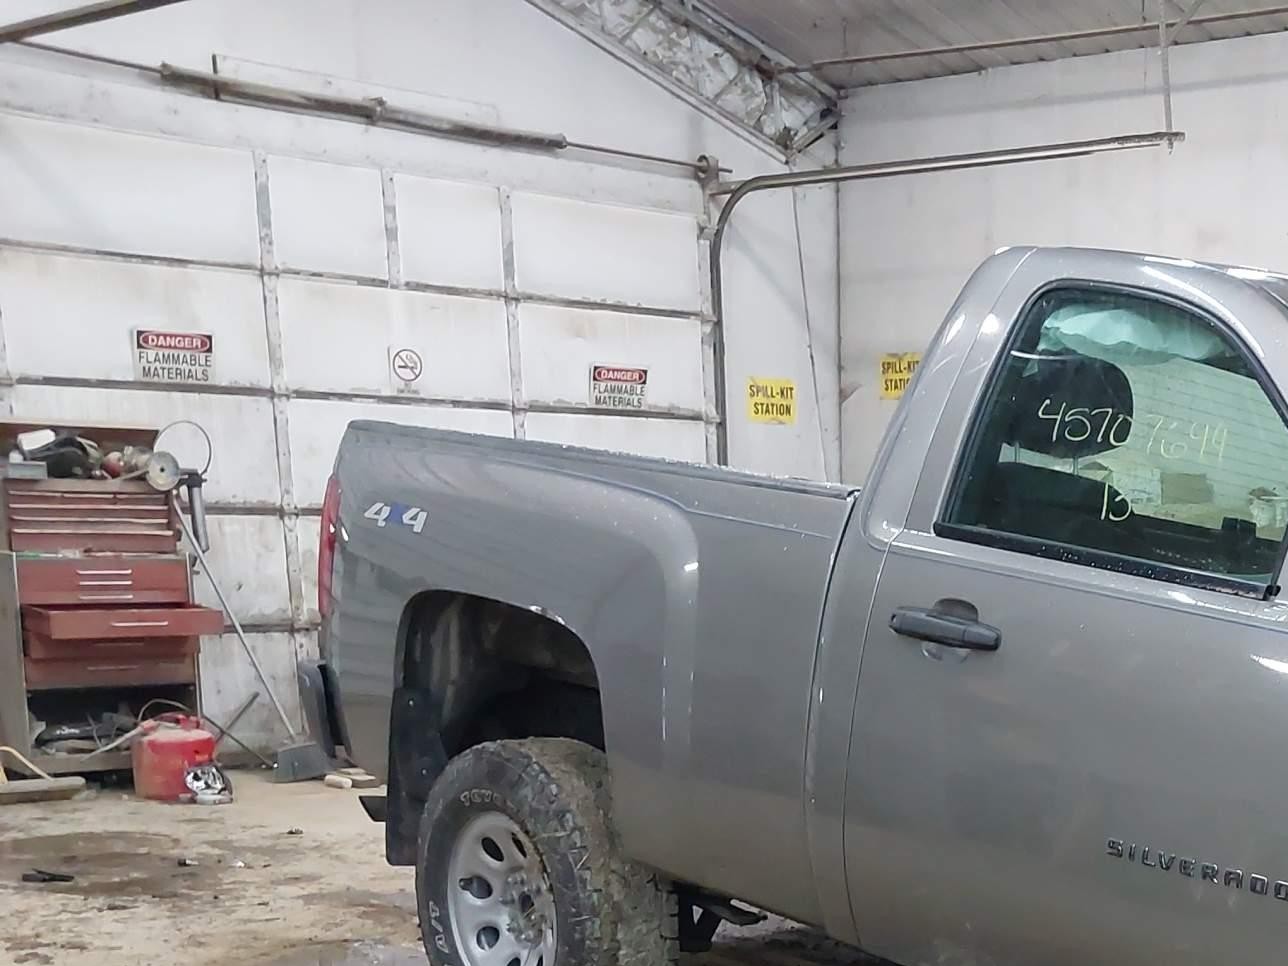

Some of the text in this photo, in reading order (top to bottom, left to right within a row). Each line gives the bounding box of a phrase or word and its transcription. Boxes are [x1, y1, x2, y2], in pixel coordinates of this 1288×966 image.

[148, 335, 202, 349] DANGER
[138, 351, 212, 367] FLAMMABLE
[142, 365, 209, 382] MATERIALS
[600, 370, 640, 381] DANGER
[593, 382, 646, 397] FLAMMABLE
[749, 384, 794, 400] SPILL-KIT
[884, 378, 911, 392] STATI
[595, 395, 643, 409] MATERIALS
[753, 402, 792, 416] STATION
